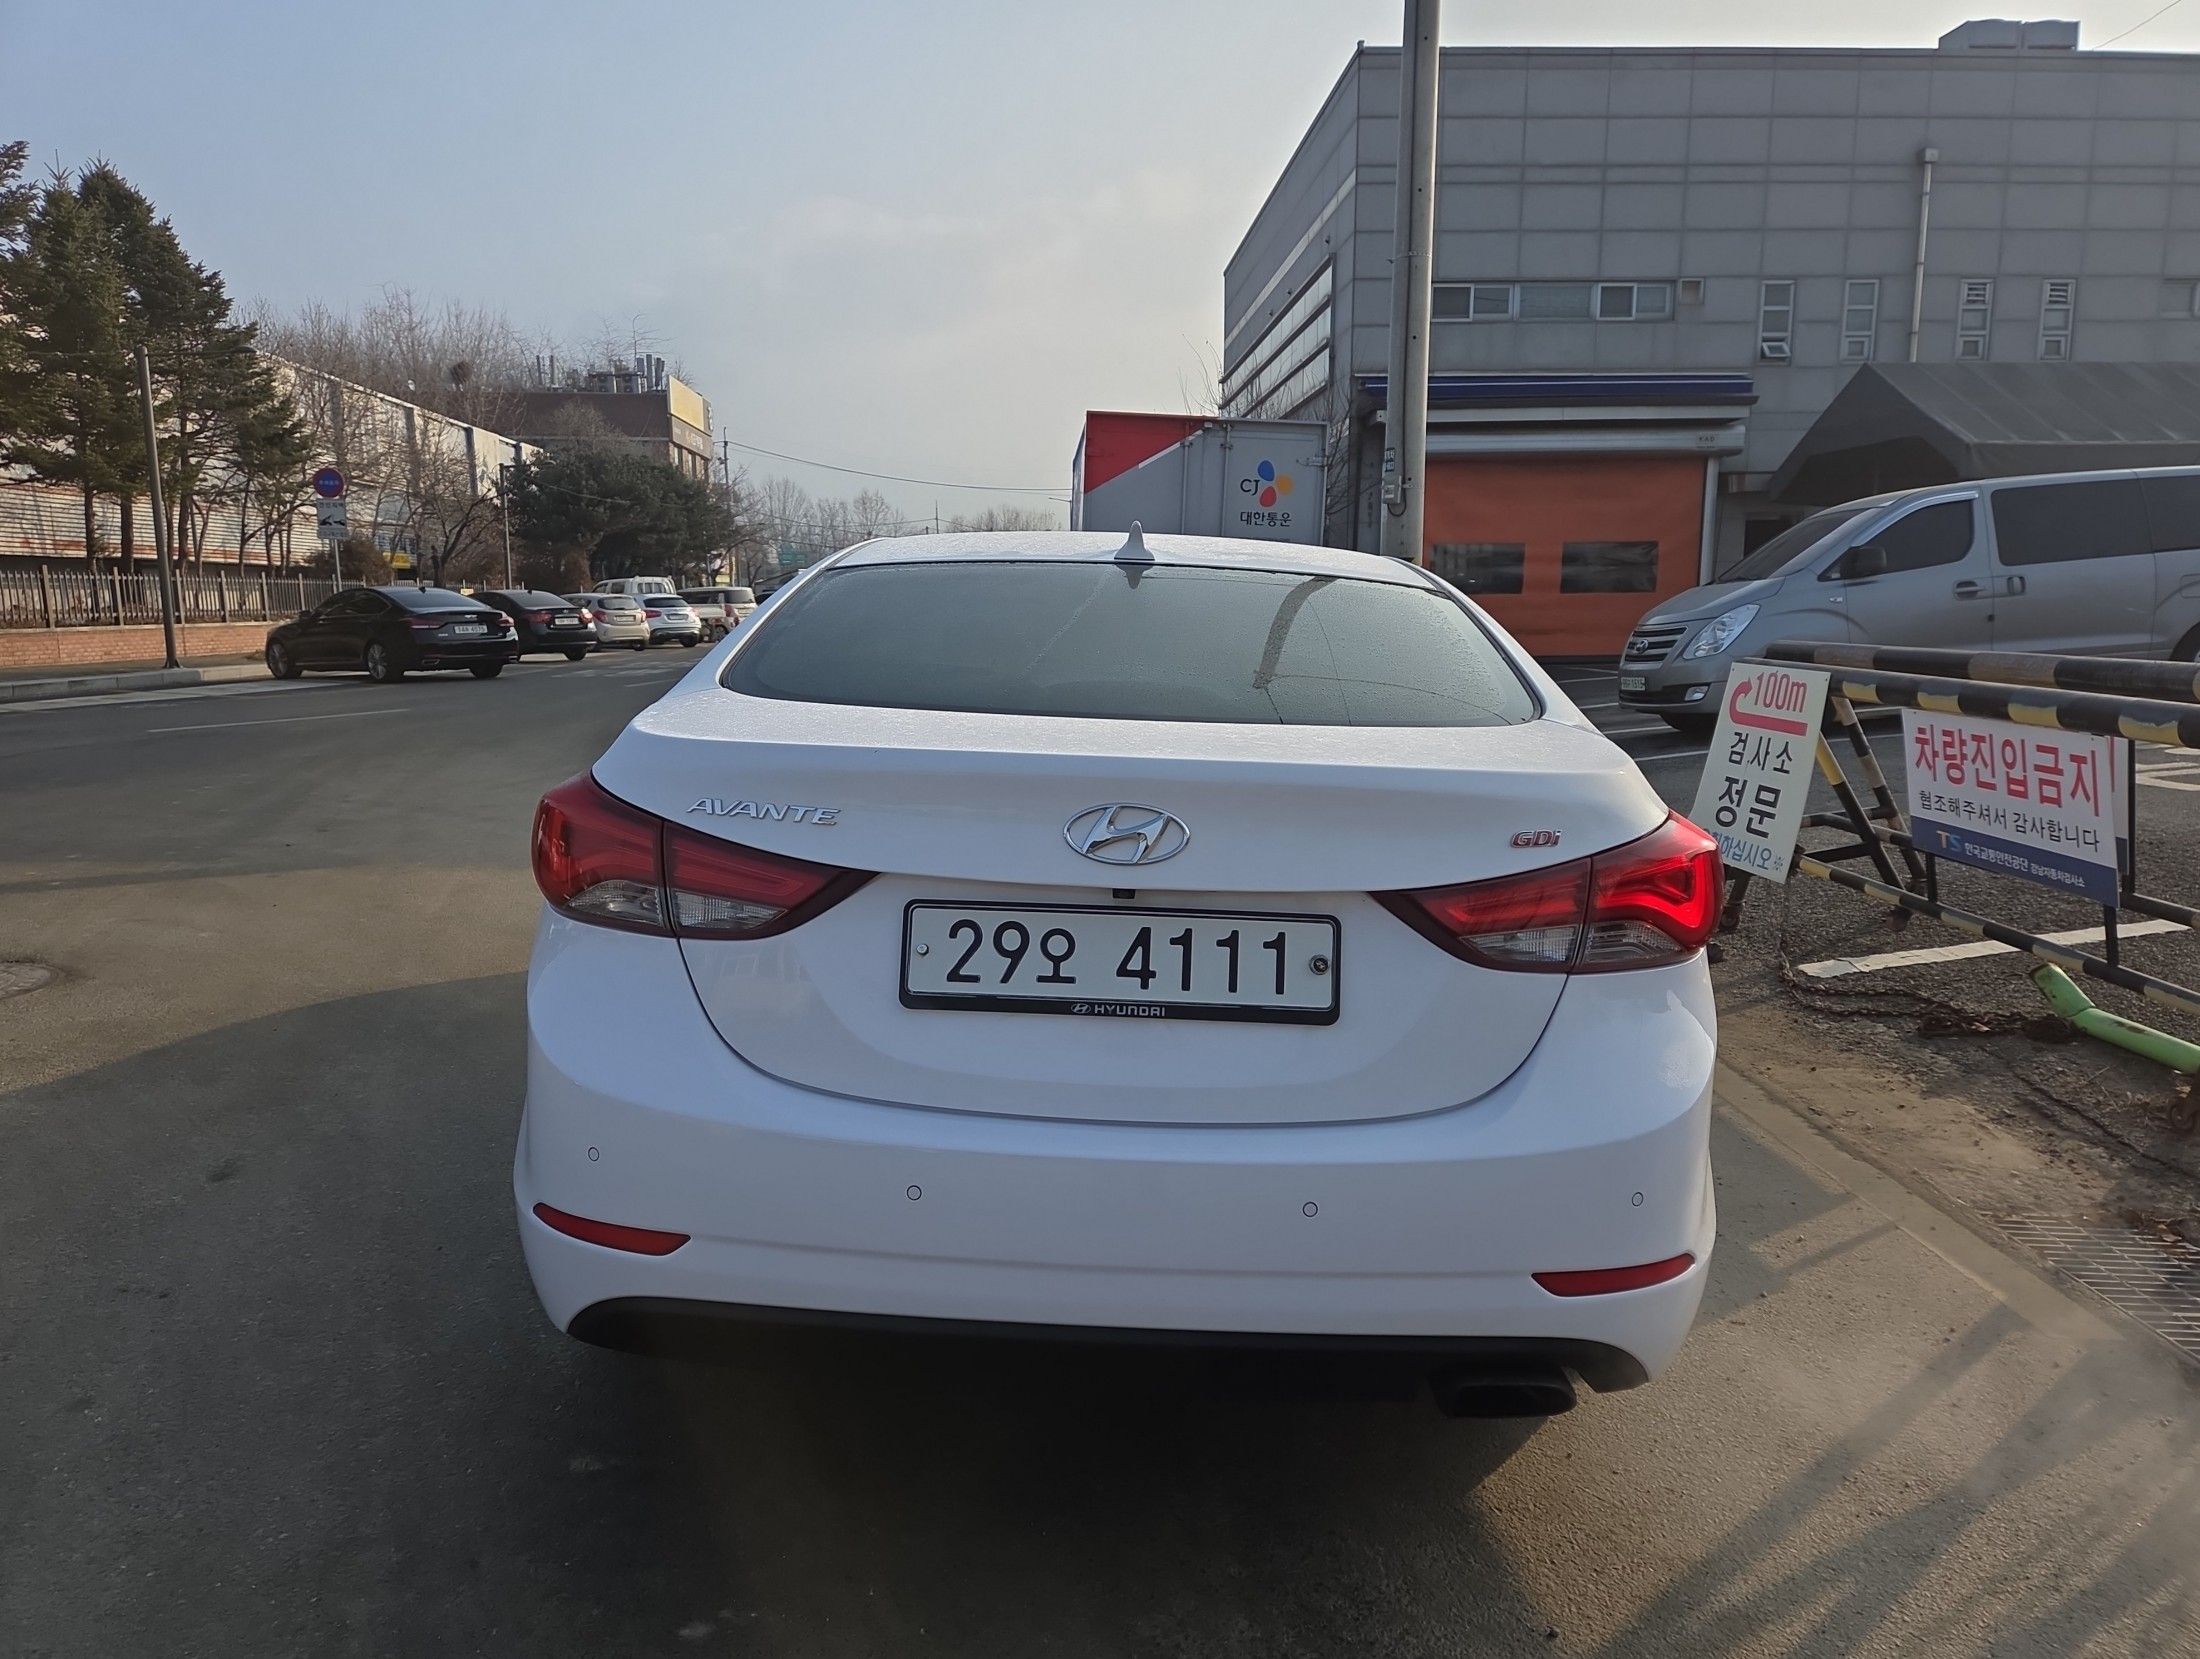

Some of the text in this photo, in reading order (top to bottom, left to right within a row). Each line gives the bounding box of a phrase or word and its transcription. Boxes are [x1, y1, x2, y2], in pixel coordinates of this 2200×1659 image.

[1240, 478, 1260, 496] CJ
[1240, 511, 1292, 527] 대한통운
[1754, 670, 1807, 713] 100m
[1728, 731, 1793, 775] 검사소
[1915, 724, 2100, 817] 차량진입금지
[686, 798, 842, 826] AVANTE
[1715, 775, 1782, 839] 정문
[1918, 789, 2101, 853] 협조해주셔서 감사합니다
[1510, 829, 1563, 848] GDi
[1936, 830, 1962, 852] TS
[945, 918, 1287, 995] 29오 4111
[1094, 1003, 1166, 1017] HYUNDAI
